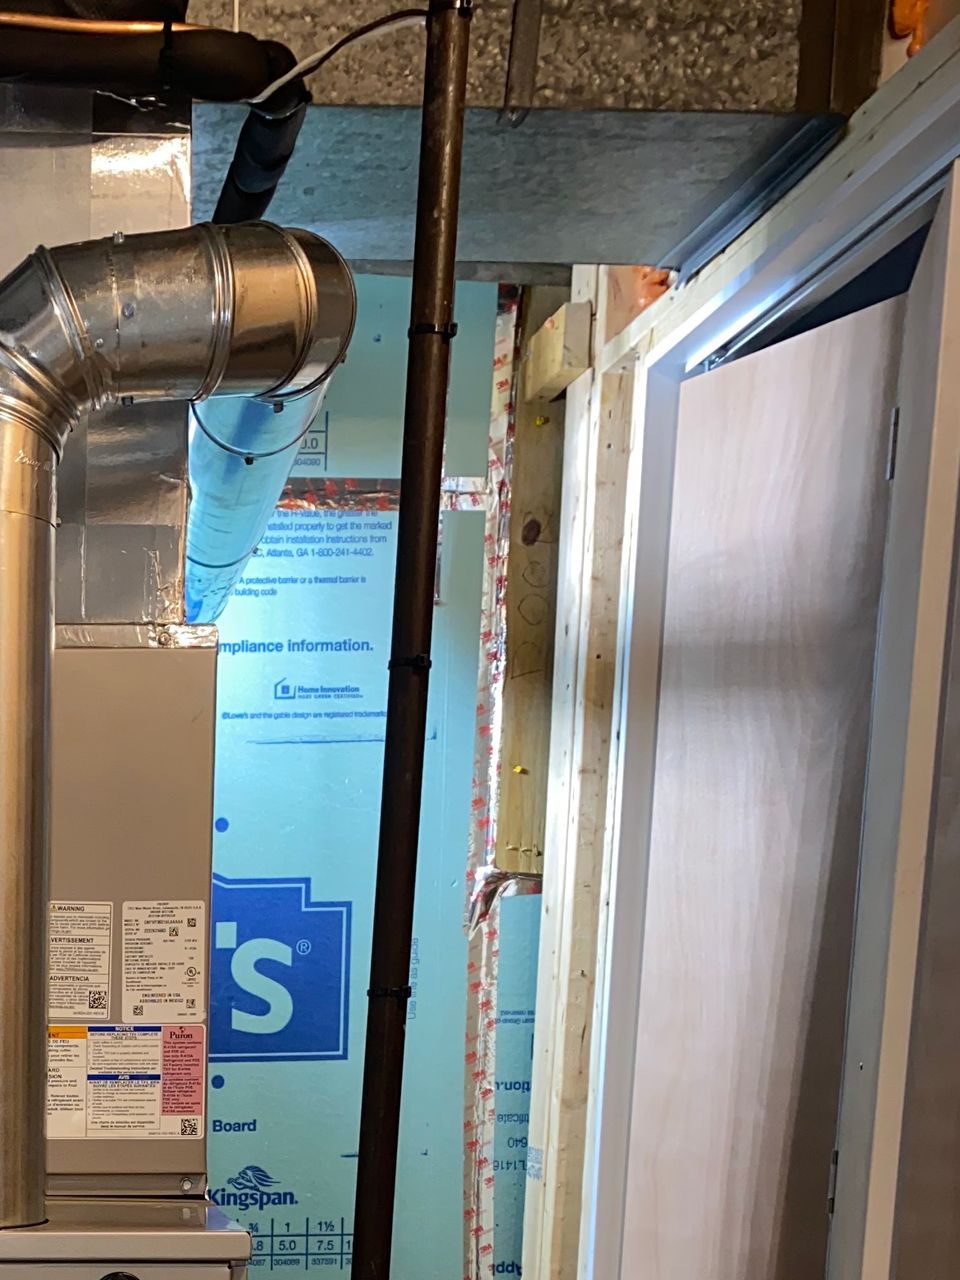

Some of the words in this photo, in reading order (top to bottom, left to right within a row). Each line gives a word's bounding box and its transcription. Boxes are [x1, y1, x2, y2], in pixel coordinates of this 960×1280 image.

[295, 522, 324, 532] properly
[327, 522, 334, 530] to
[336, 522, 348, 532] get
[350, 521, 361, 530] the
[364, 521, 392, 530] marked
[286, 535, 324, 544] installation
[326, 535, 368, 543] instructions
[370, 535, 387, 543] from
[296, 548, 309, 556] GA
[288, 638, 374, 652] information.
[320, 685, 359, 693] Innovation
[407, 1000, 416, 1020] Use
[169, 1031, 193, 1039] Puron
[213, 1119, 257, 1132] Board
[284, 1222, 290, 1232] 1
[279, 1240, 296, 1251] 5.0
[317, 1240, 334, 1251] 7.5
